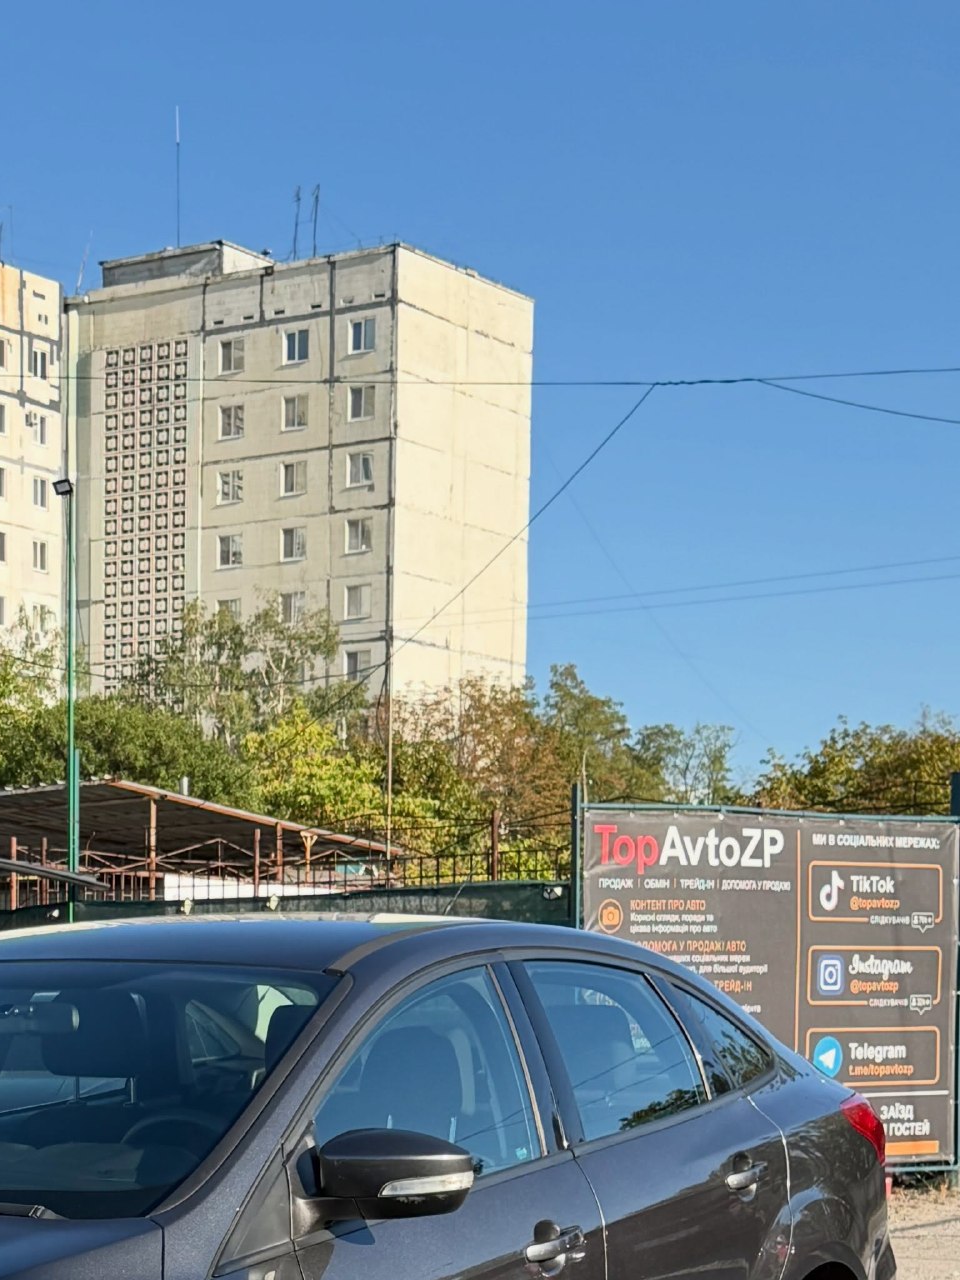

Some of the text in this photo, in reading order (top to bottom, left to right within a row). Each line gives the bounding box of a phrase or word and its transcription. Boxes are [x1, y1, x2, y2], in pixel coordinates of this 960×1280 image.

[812, 833, 940, 849] МИ В СОЦІАЛЬНИХ МЕРЕЖАХ:
[593, 824, 785, 875] TopAvtoZP
[598, 878, 634, 890] ПРОДАЖ
[644, 878, 670, 889] ОБМІН
[721, 879, 757, 891] ДОПОМОГА
[757, 880, 763, 890] У
[850, 875, 895, 894] TikTok
[630, 899, 706, 911] КОНТЕНТ ПРО АВТО
[850, 896, 900, 911] @topavtozp
[679, 940, 686, 951] У
[726, 940, 746, 951] АВТО
[848, 954, 914, 980] Instagram
[850, 979, 899, 994] @topavtozp
[848, 1042, 907, 1063] Telegram
[880, 1102, 914, 1121] ЗАЇЗД
[889, 1119, 931, 1136] ГОСТЕЙ
